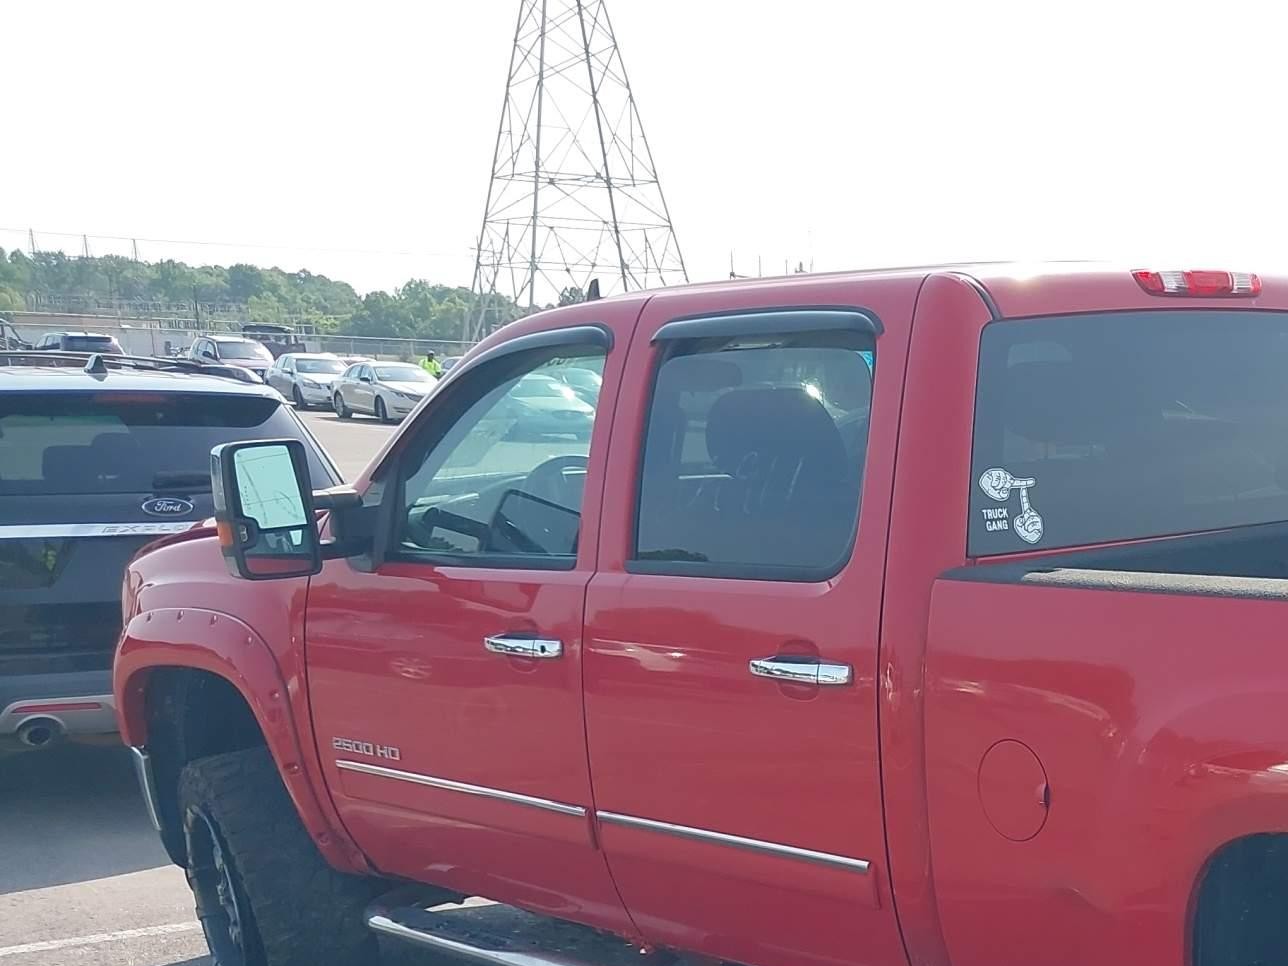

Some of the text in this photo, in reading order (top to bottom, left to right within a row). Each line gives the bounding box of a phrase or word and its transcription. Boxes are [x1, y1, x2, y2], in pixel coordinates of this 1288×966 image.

[154, 500, 181, 512] Ford
[982, 507, 1009, 520] TRUCK
[986, 519, 1009, 532] GANG
[332, 736, 401, 761] 2500 HD
